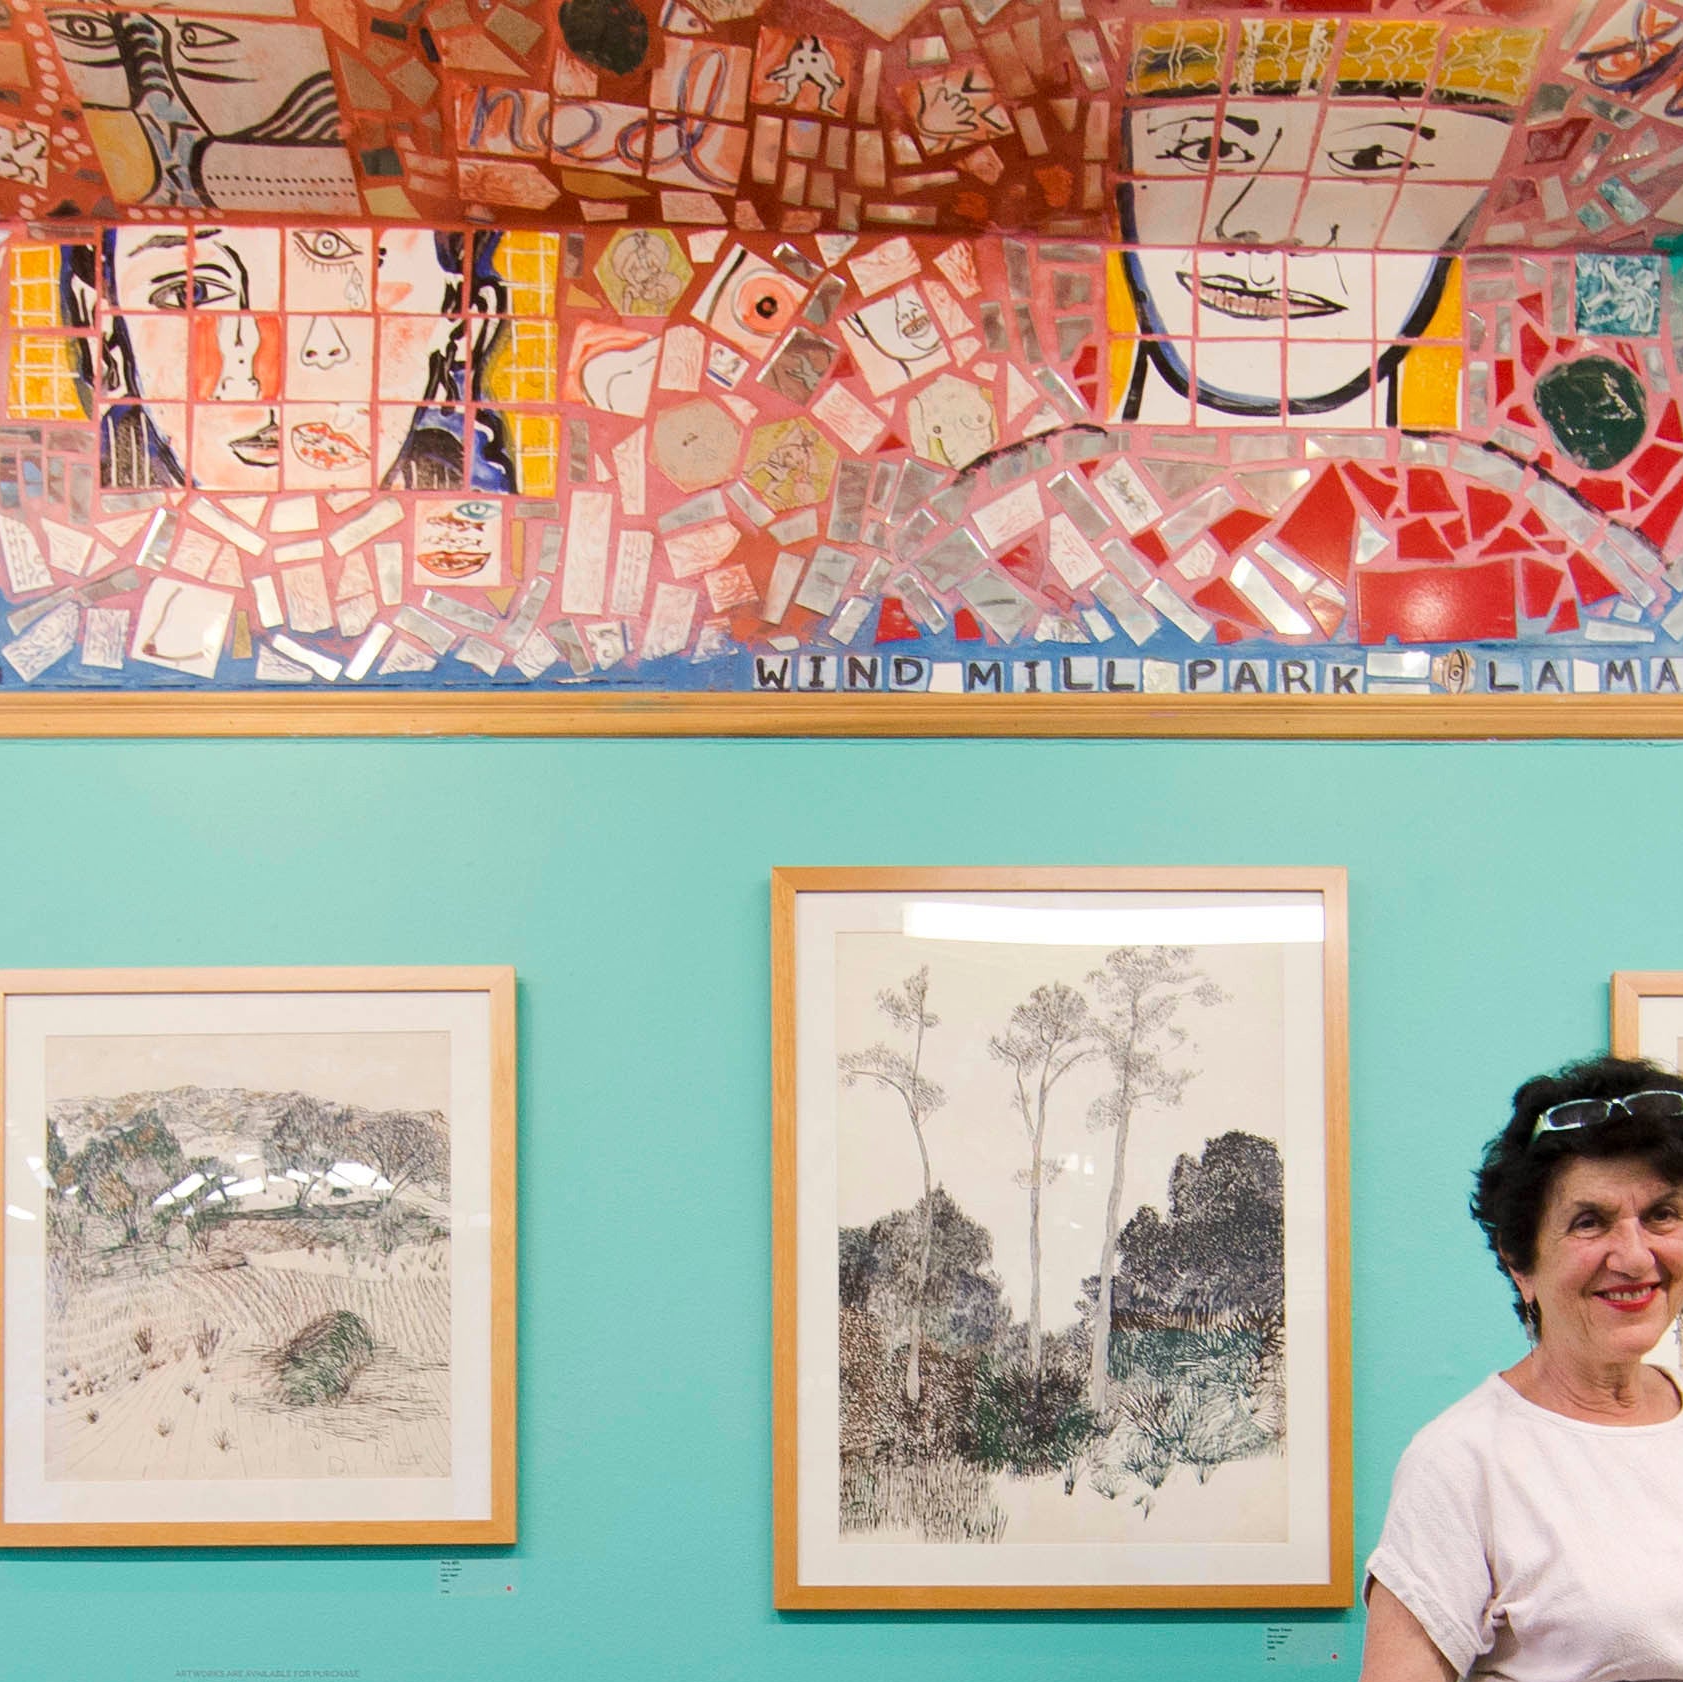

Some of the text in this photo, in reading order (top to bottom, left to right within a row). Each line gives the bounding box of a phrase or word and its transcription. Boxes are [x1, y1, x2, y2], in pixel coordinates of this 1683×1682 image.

[754, 656, 924, 690] WIND
[967, 656, 1135, 692] MILL
[1187, 658, 1361, 694] PARK
[1486, 660, 1566, 692] LA
